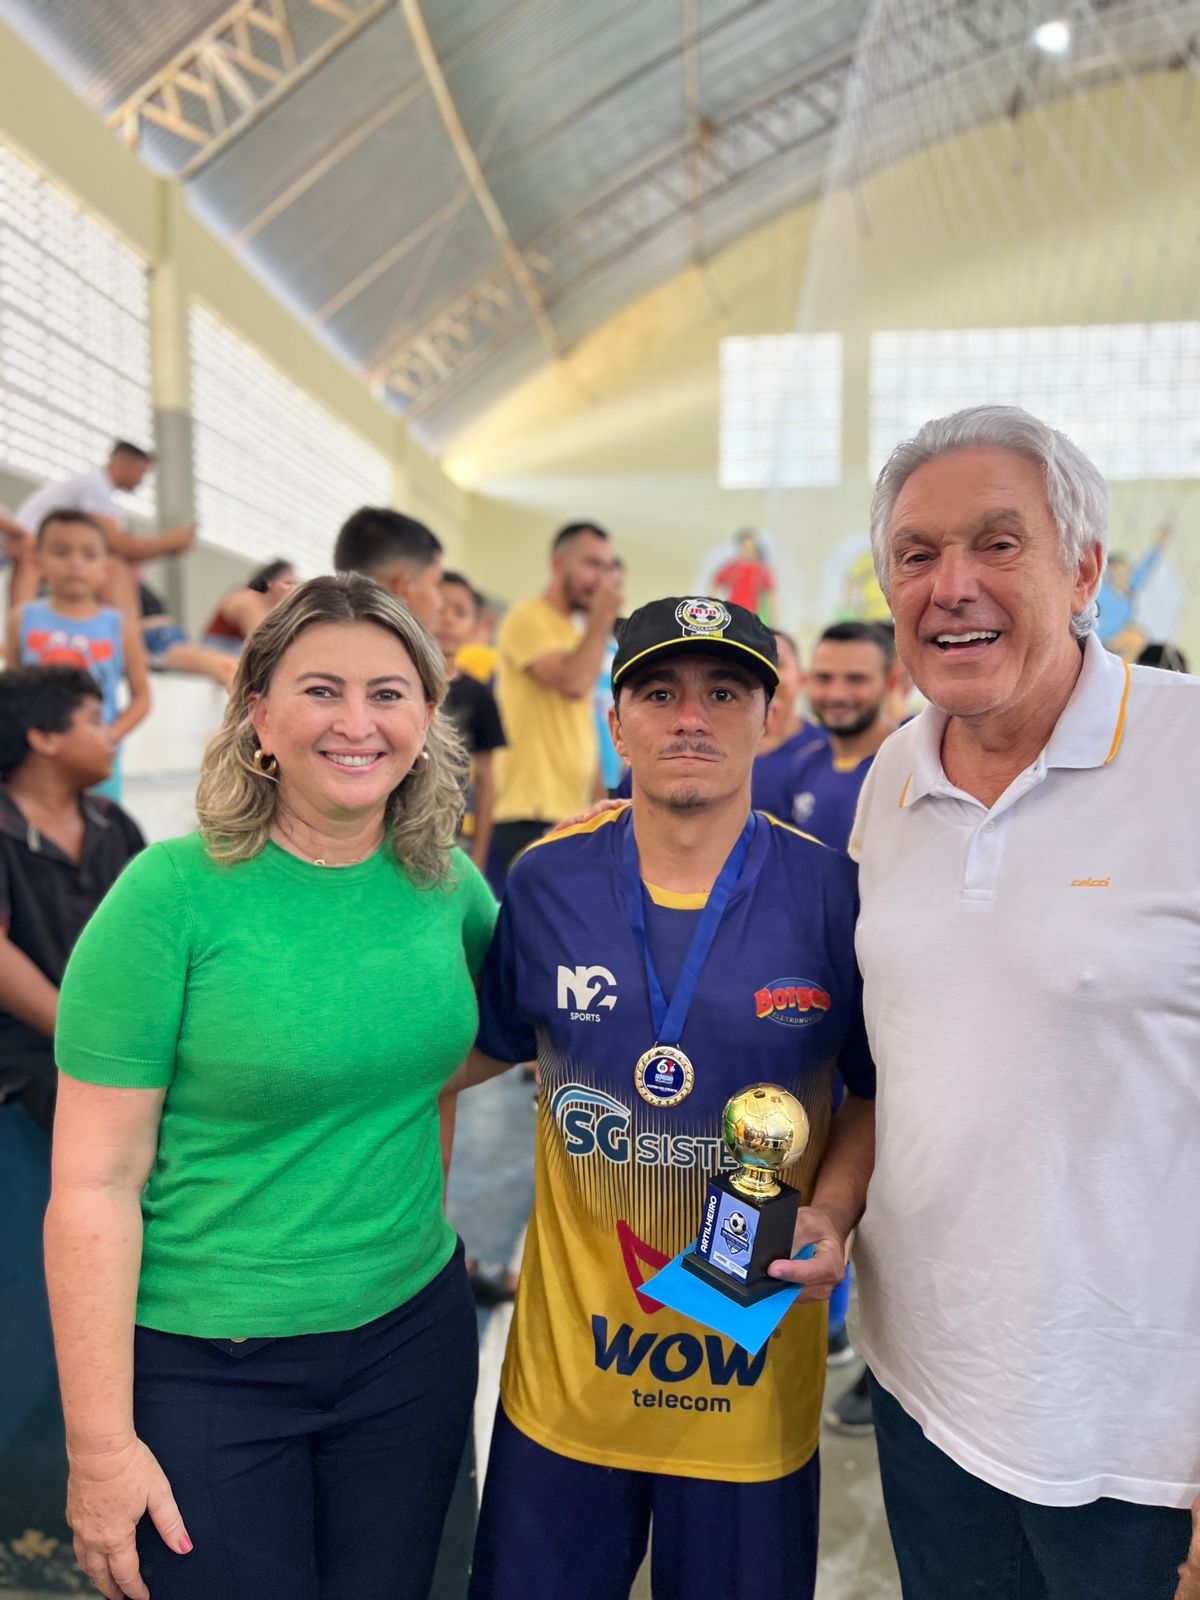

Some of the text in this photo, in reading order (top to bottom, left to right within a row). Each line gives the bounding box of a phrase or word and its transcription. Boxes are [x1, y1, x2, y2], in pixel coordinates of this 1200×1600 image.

[557, 965, 617, 1011] N2
[570, 1012, 601, 1023] SPORTS
[564, 1108, 630, 1165] SG
[700, 1195, 717, 1254] ARTILHEIRO
[591, 1314, 769, 1387] WOW
[632, 1388, 731, 1413] telecom
